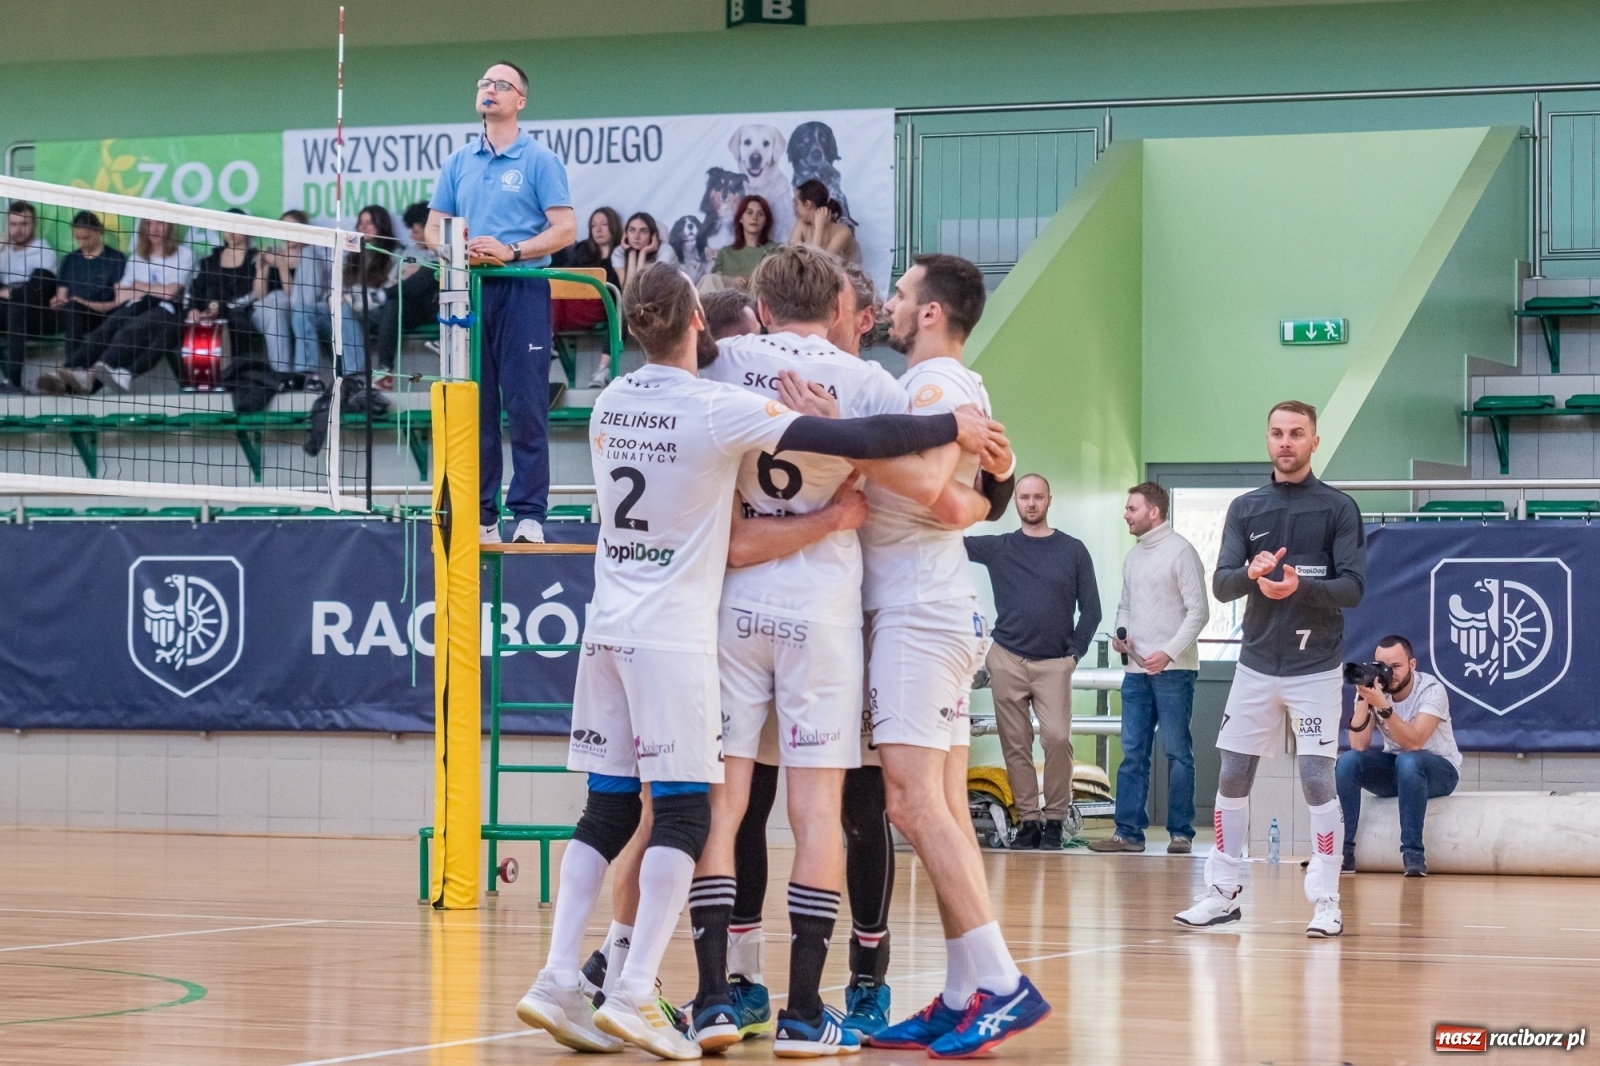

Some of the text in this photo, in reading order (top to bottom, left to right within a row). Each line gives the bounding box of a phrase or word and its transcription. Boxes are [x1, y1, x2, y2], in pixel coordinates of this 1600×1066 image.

[731, 0, 744, 22] B
[762, 0, 793, 19] B
[302, 134, 453, 175] WSZYSTKO
[136, 160, 260, 205] ZOO
[600, 411, 677, 430] ZIELIŃSKI
[757, 450, 803, 501] 6
[610, 466, 649, 532] 2
[736, 612, 808, 643] glass
[1295, 629, 1311, 650] 7
[1299, 717, 1322, 726] ZOO
[1299, 725, 1322, 734] MAR
[800, 728, 842, 747] kolgraf
